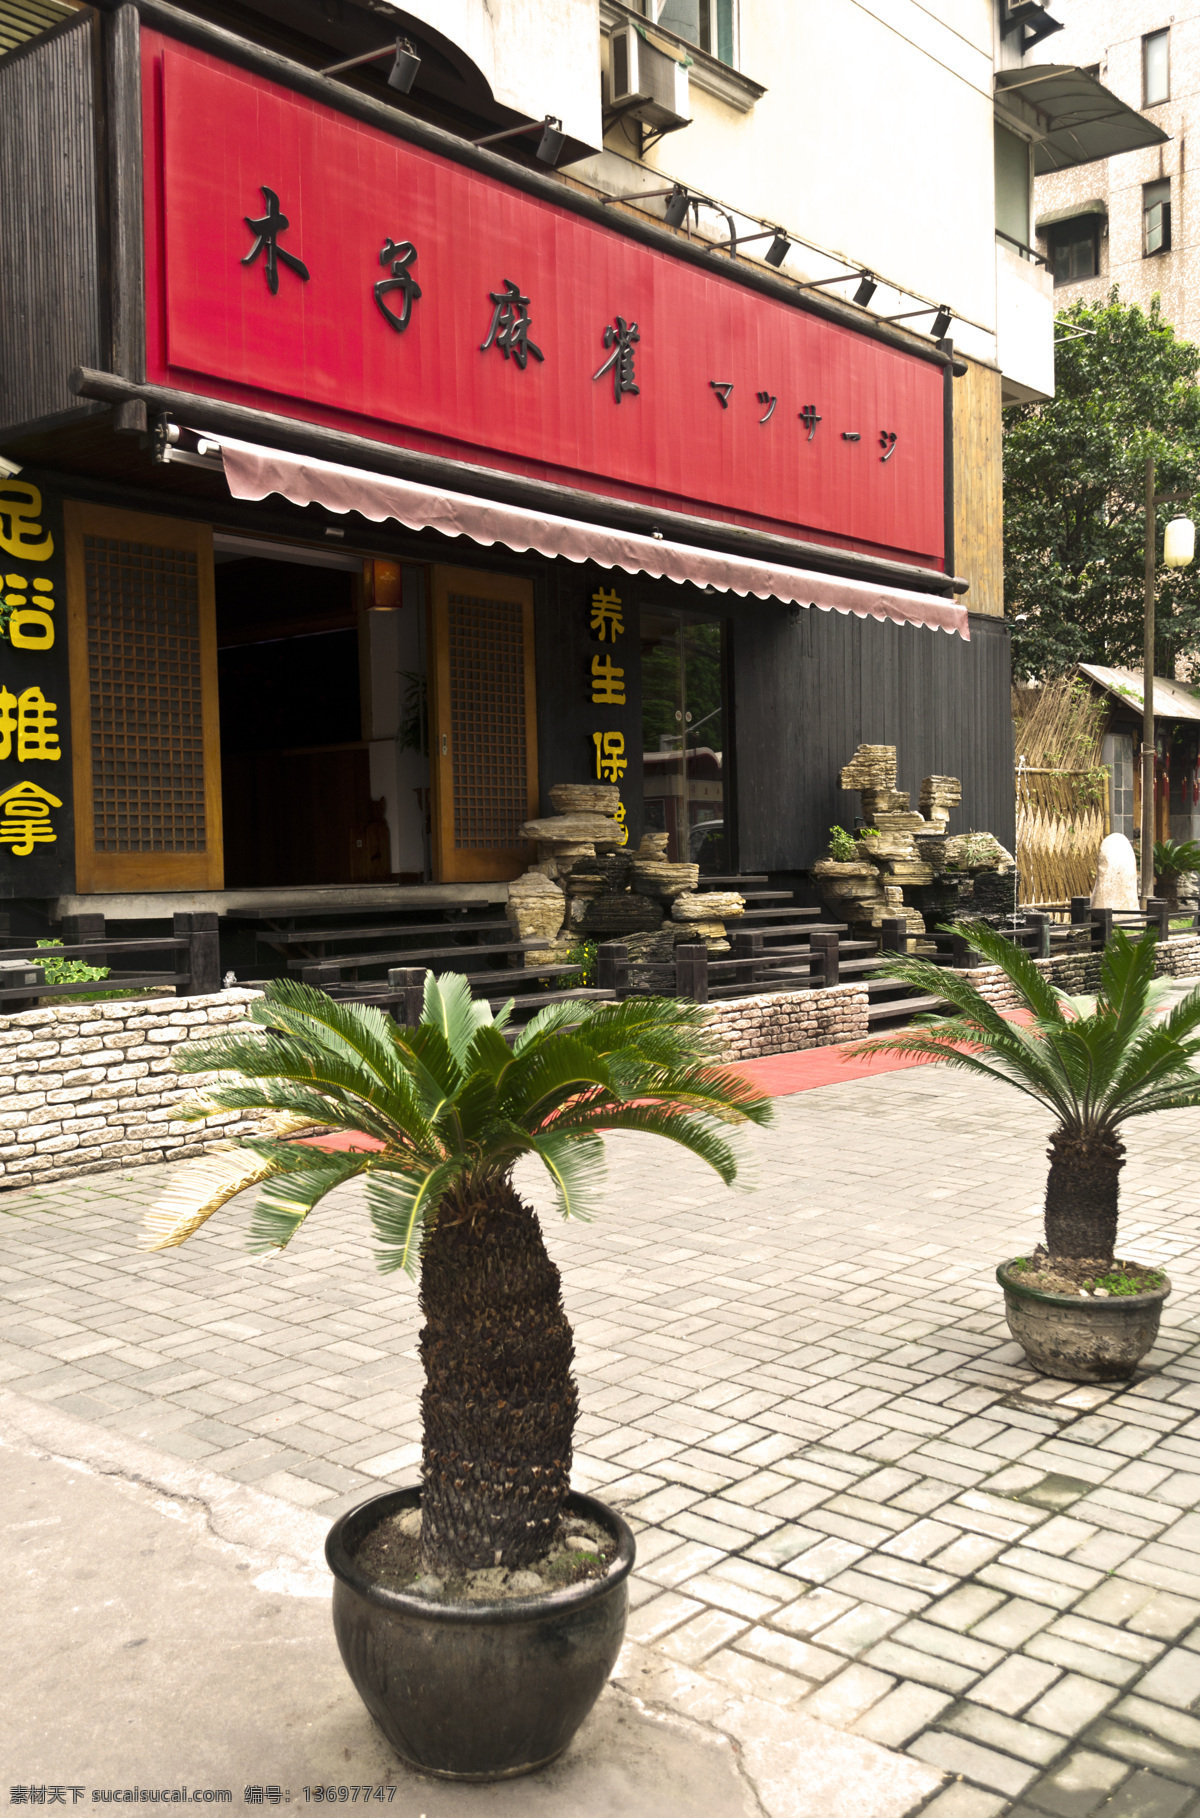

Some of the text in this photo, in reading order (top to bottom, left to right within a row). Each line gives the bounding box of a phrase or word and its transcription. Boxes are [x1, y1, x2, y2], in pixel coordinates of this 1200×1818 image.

[241, 186, 640, 404] 木子麻雀
[590, 586, 629, 846] 养生保
